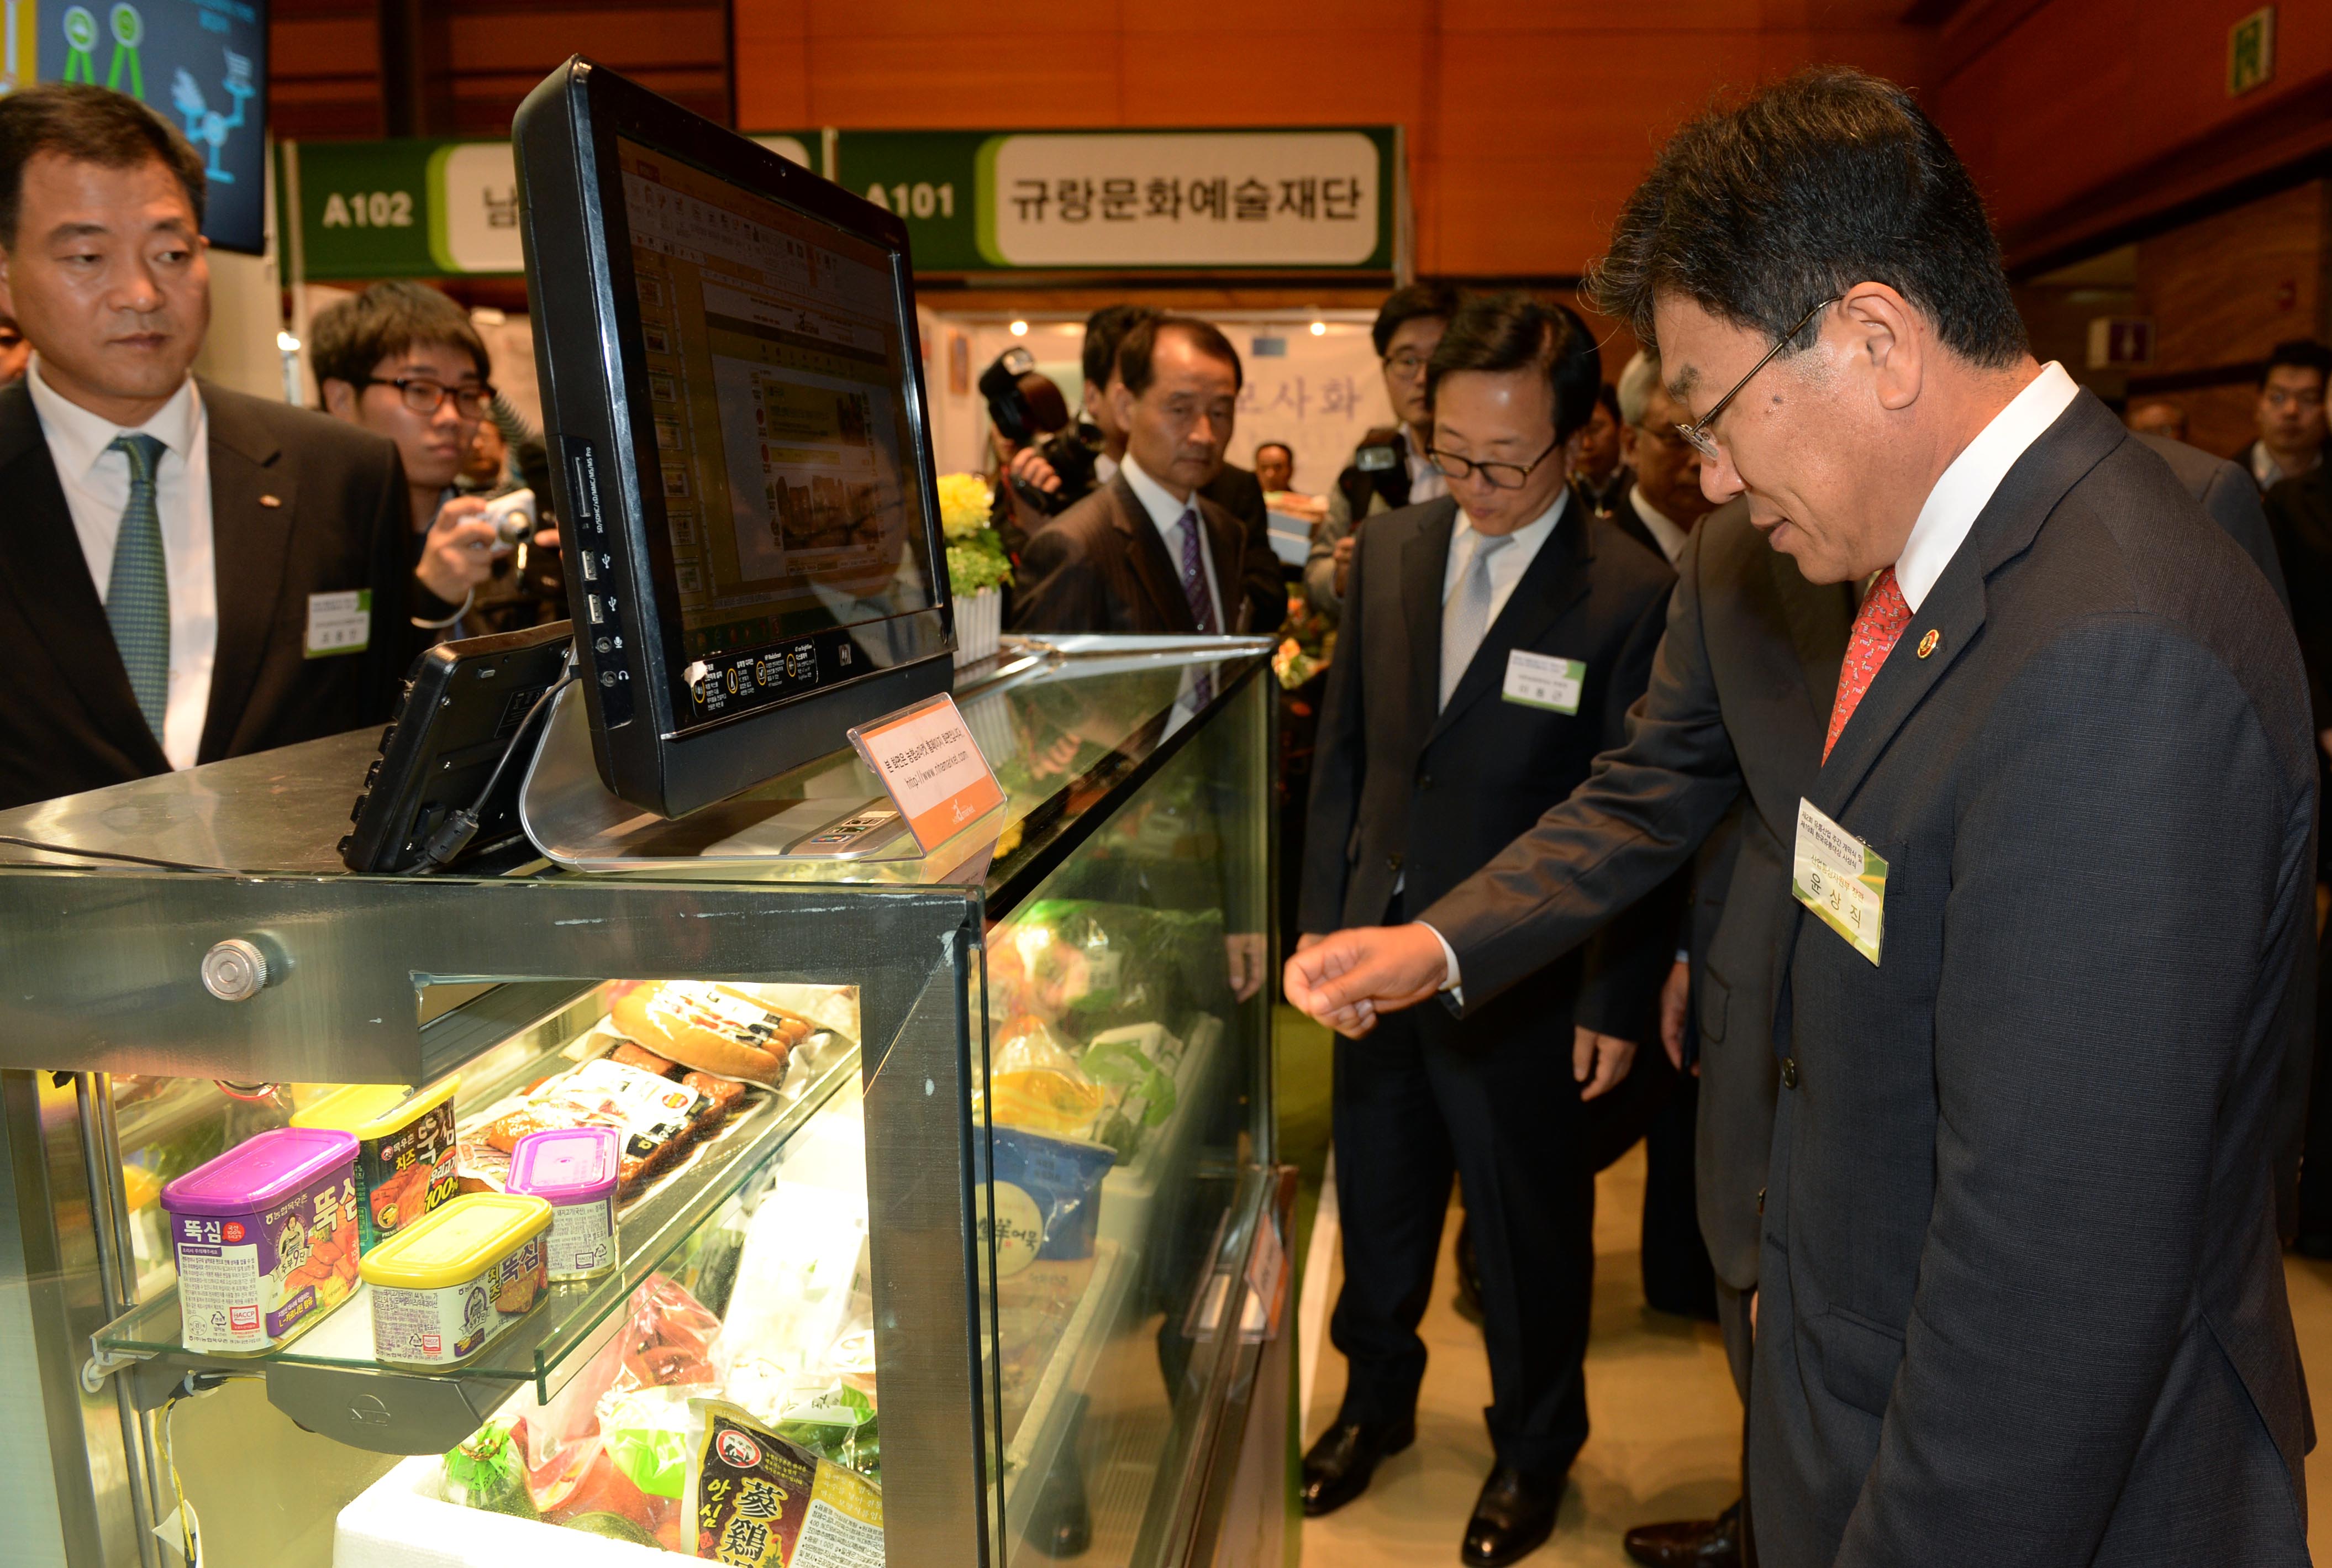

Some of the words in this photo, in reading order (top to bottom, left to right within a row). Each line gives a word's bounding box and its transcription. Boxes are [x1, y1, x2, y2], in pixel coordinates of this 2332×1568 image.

[323, 191, 413, 228] A102
[866, 182, 954, 218] A101
[1011, 177, 1363, 224] 규랑문화예술재단
[1802, 811, 1813, 823] 제2회
[1832, 835, 1841, 847] 주간
[396, 1149, 416, 1171] 치즈
[425, 1177, 459, 1213] 100%
[184, 1220, 221, 1243] 뚝심
[502, 1236, 539, 1283] 뚝심
[488, 1264, 501, 1304] 치즈
[699, 1479, 731, 1528] 안심
